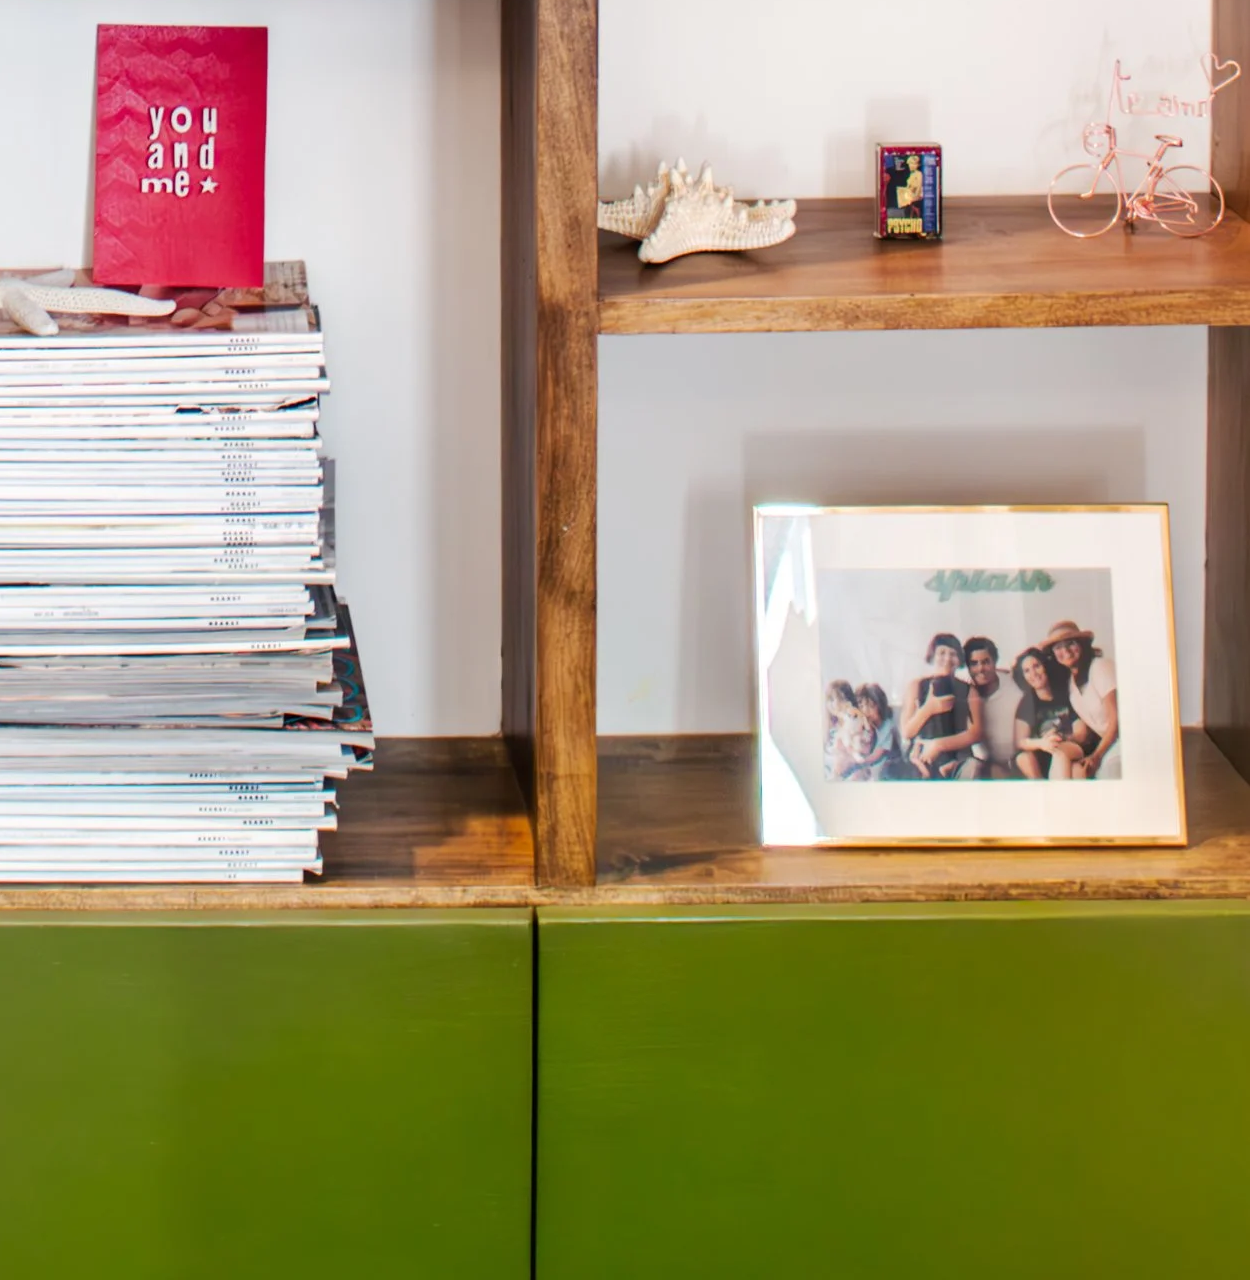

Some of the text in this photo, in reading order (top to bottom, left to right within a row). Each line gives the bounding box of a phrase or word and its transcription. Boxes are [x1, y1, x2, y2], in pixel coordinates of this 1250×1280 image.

[148, 105, 218, 140] you
[147, 136, 215, 170] and
[141, 170, 190, 197] me
